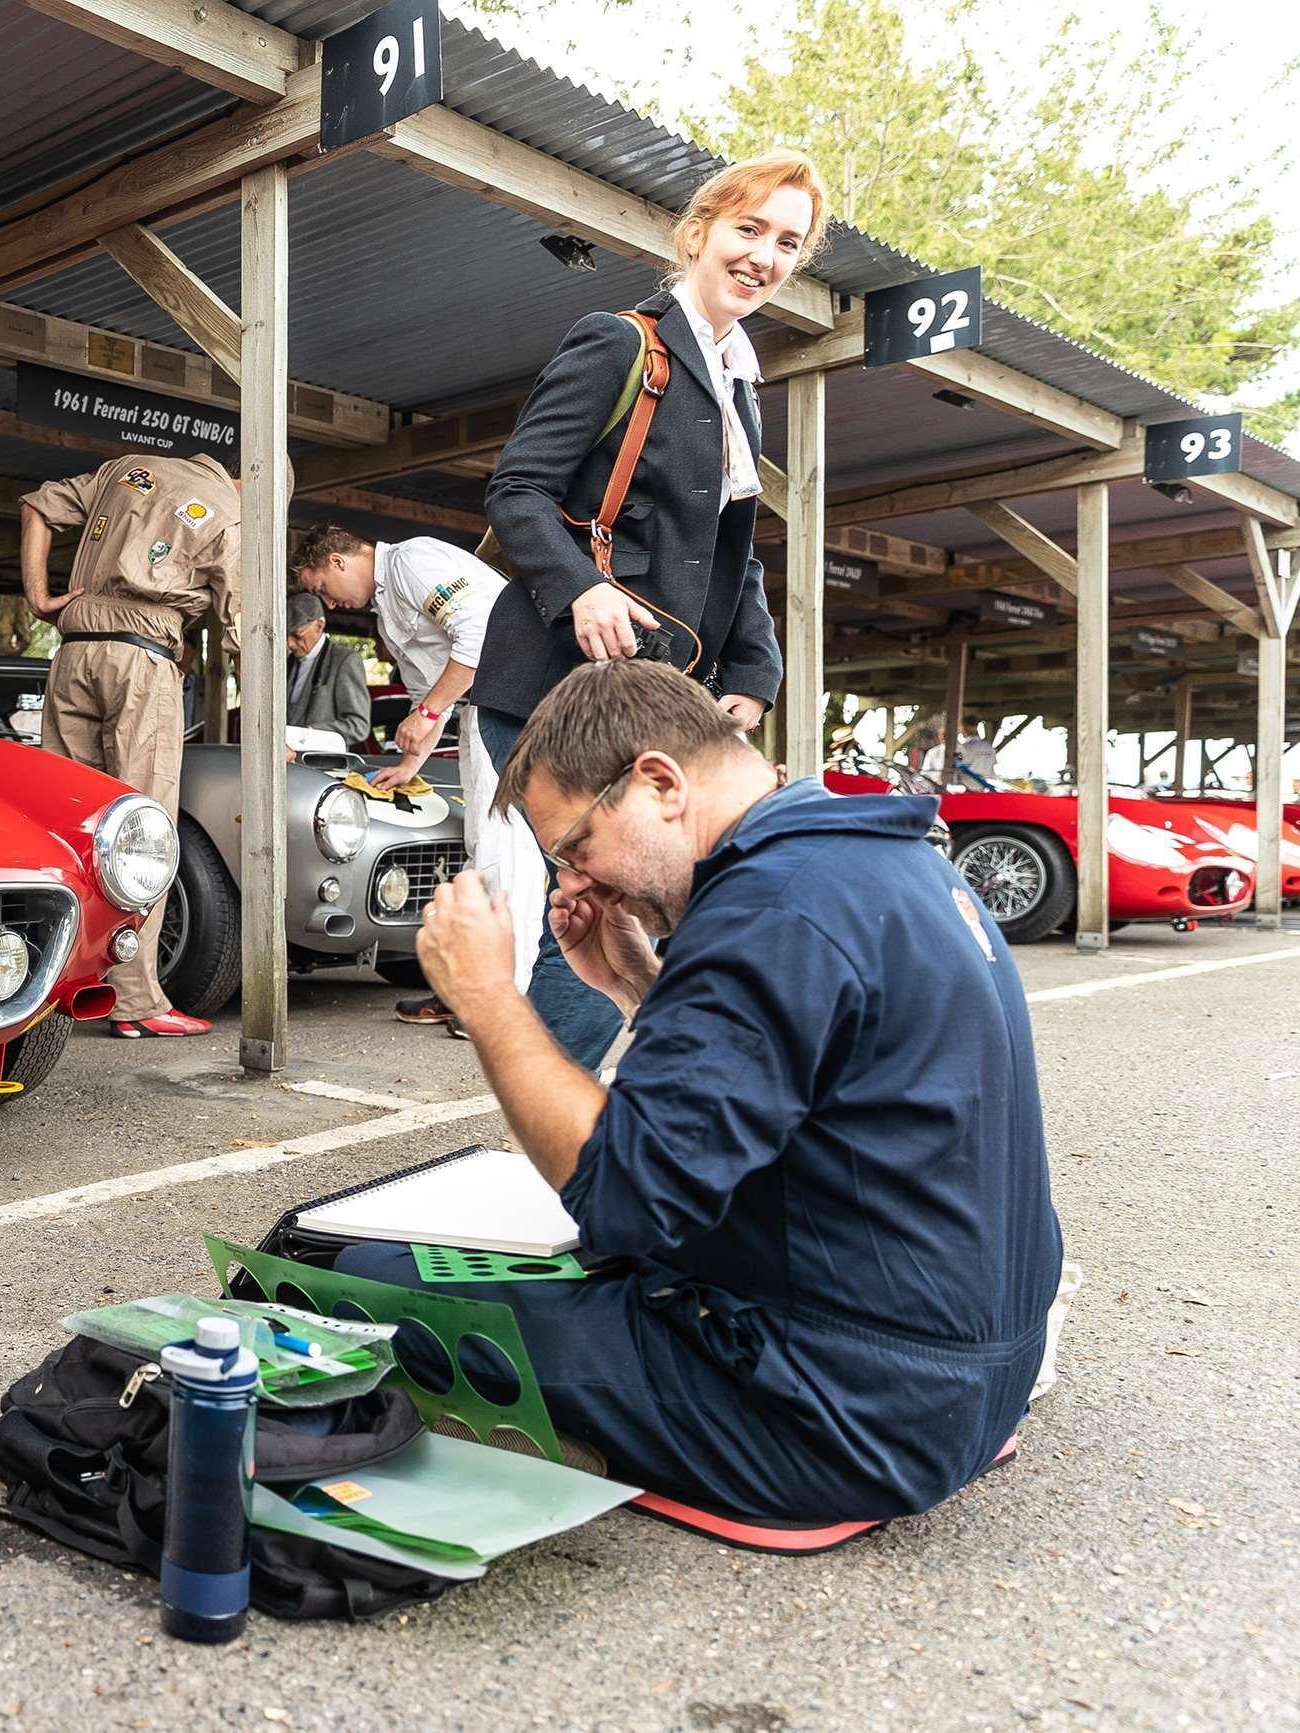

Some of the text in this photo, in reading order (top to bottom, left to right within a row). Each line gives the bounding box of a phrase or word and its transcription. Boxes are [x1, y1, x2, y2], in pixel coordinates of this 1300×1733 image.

[373, 16, 425, 96] 91
[907, 290, 970, 338] 92
[53, 388, 235, 445] 1961 Ferrari 250 GT SWB/C
[121, 431, 174, 450] LAVANT CUP
[1180, 428, 1232, 464] 93
[427, 577, 469, 617] MECHANIC
